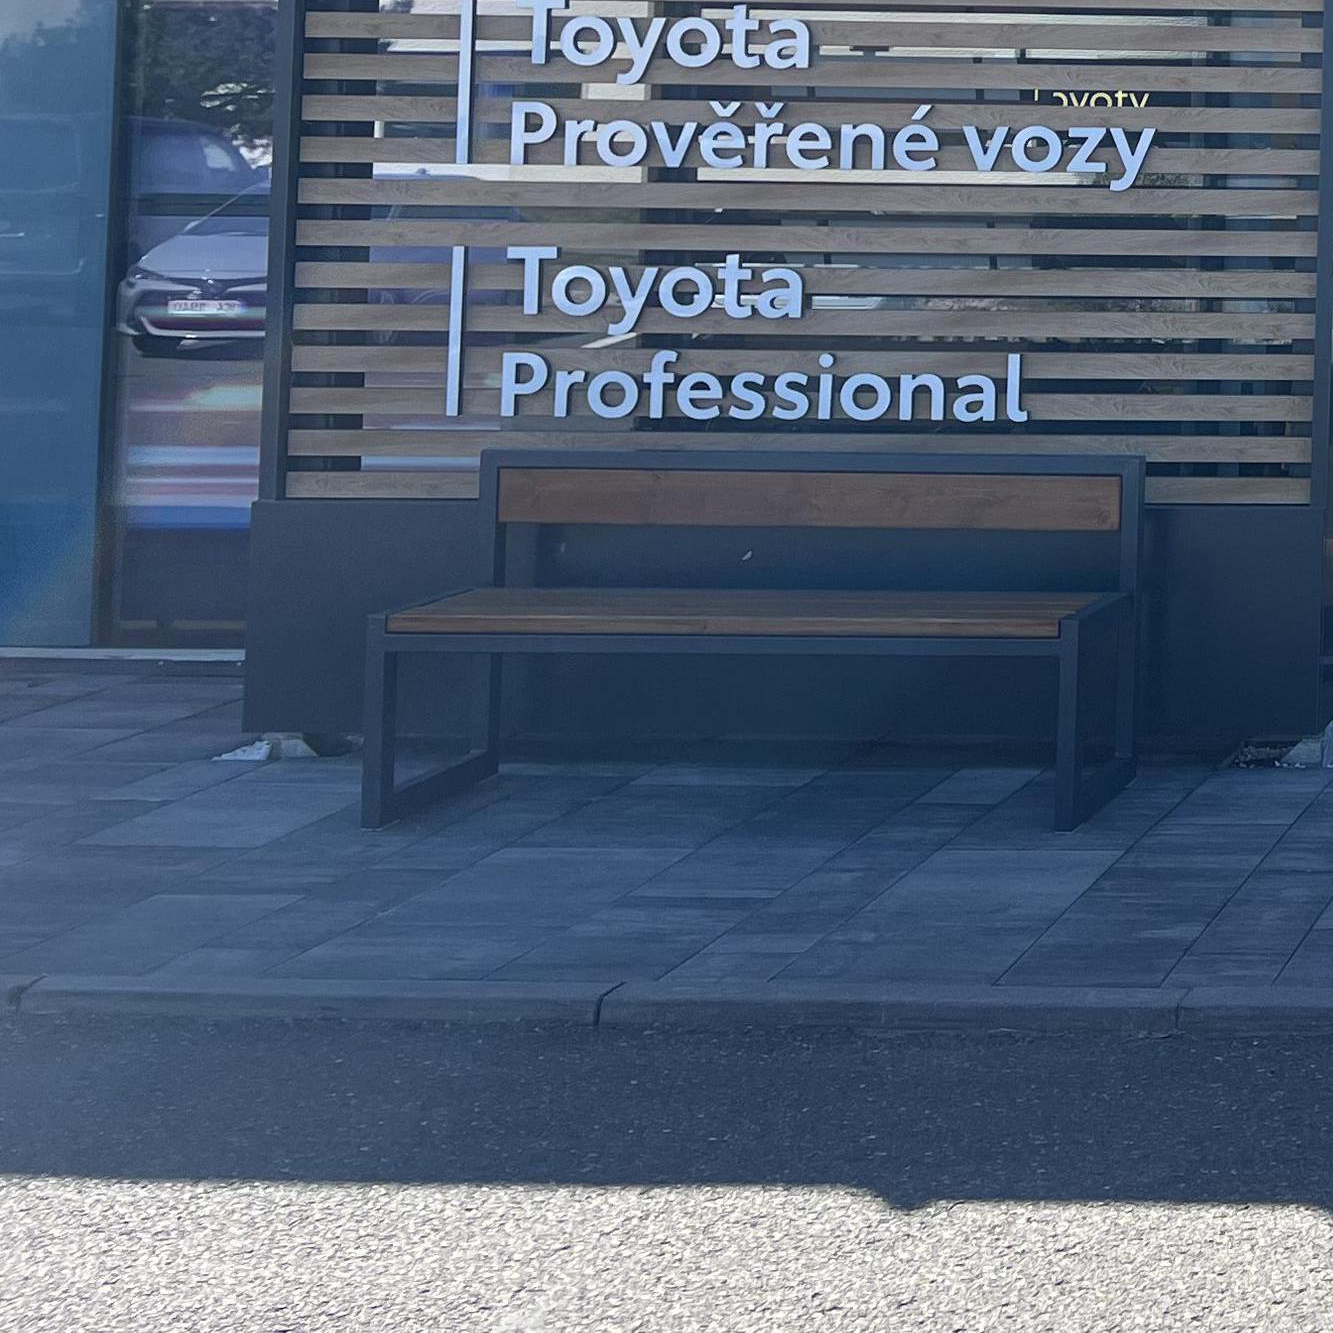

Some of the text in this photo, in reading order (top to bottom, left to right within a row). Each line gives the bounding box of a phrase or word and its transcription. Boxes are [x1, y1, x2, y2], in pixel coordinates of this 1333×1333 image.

[511, 101, 1158, 191] Prověřené vozy
[507, 246, 803, 336] Toyota
[501, 350, 1029, 423] Professional
